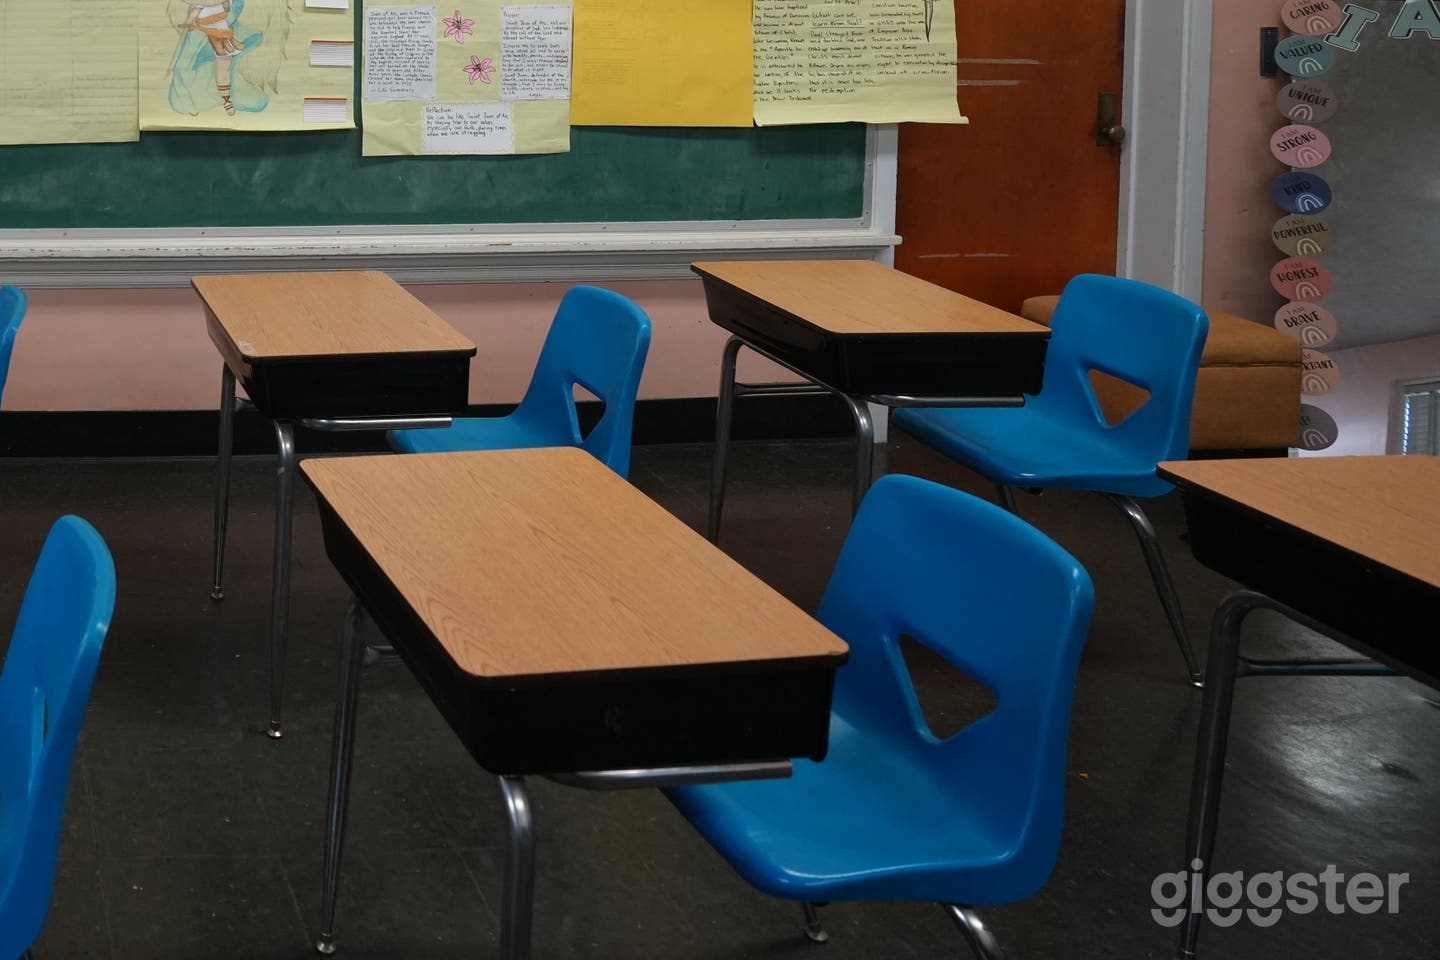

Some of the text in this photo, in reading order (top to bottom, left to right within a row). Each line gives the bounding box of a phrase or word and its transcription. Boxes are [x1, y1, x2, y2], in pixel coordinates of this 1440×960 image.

[1289, 0, 1330, 20] CARING
[1324, 3, 1380, 52] I
[1279, 43, 1322, 60] VALUED
[1288, 88, 1331, 107] UNIQUE
[1277, 131, 1317, 152] STRONG
[1283, 180, 1312, 196] KIND
[1273, 223, 1328, 240] POWERFUL
[1277, 267, 1319, 283] HONEST
[1283, 310, 1321, 328] BRAVE
[1303, 360, 1334, 371] RTANT
